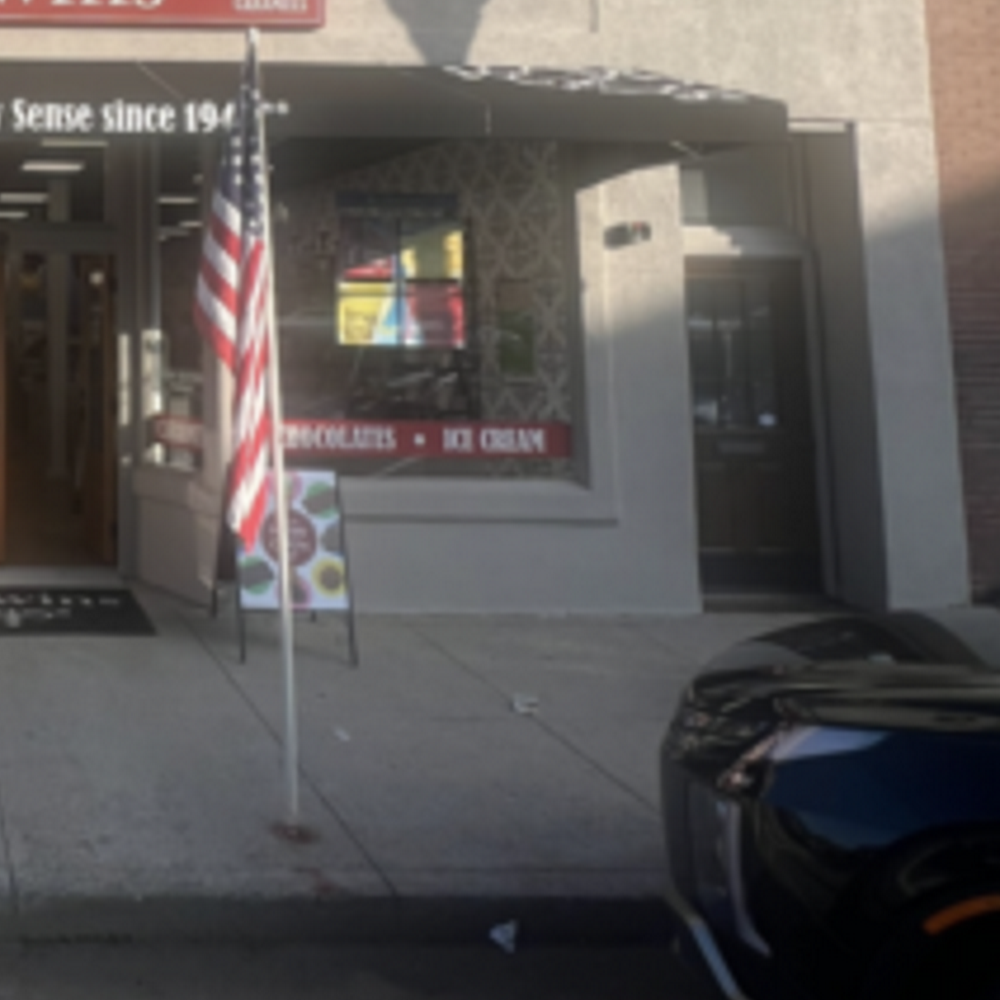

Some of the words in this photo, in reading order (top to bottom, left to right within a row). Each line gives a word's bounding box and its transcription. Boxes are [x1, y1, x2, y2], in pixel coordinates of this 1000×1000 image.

[12, 99, 94, 133] Sense
[102, 99, 176, 133] since
[443, 428, 472, 453] ICE
[480, 428, 545, 453] CREAM
